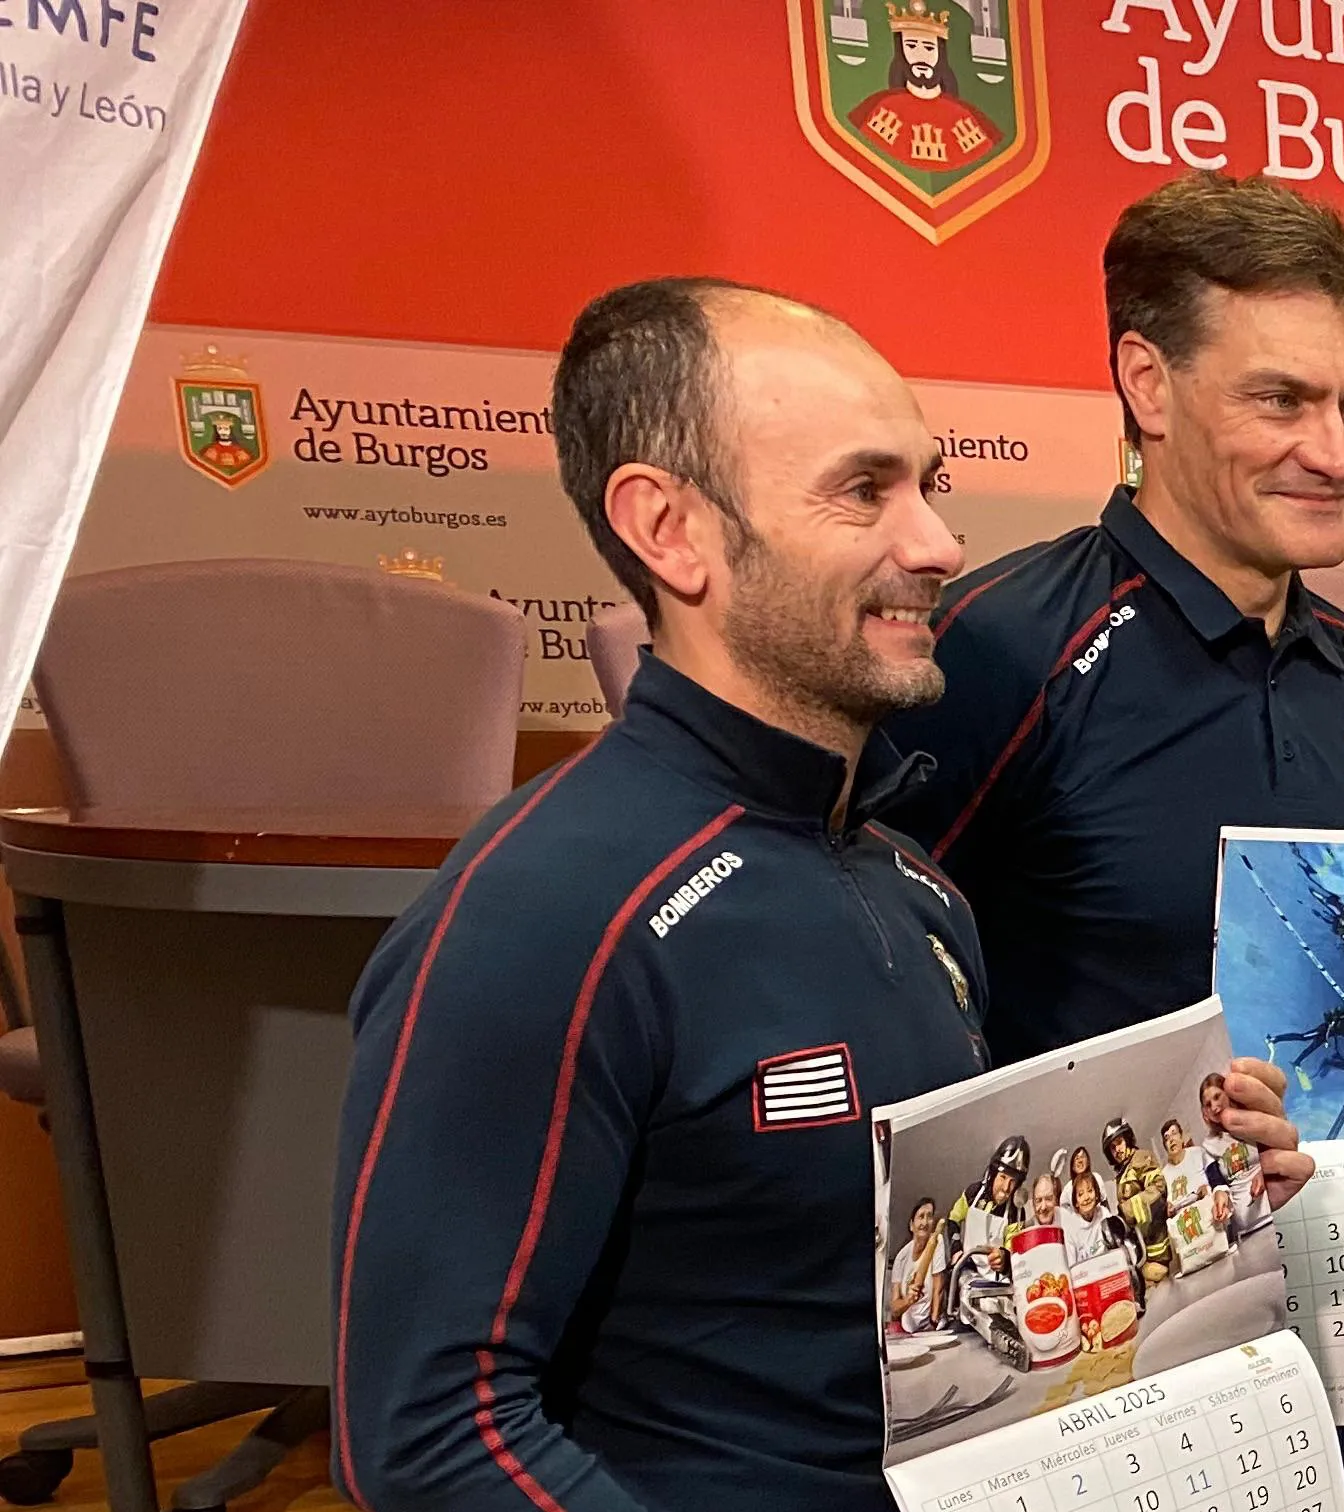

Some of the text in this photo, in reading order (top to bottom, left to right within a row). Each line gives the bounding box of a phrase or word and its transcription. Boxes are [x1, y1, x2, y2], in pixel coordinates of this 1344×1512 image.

[51, 81, 70, 118] y
[79, 81, 167, 133] León
[1104, 56, 1227, 171] de
[290, 387, 554, 435] Ayuntamient
[293, 427, 489, 477] de Burgos
[303, 506, 507, 529] www.aytoburgos.es
[1073, 605, 1136, 674] BOMOS
[649, 852, 744, 938] BOMBEROS
[937, 1368, 1299, 1512] Lunes Martes Miércoles Jueves Viernes Sábado Domingo
[1057, 1383, 1166, 1437] ABRIL 2025
[1071, 1474, 1088, 1496] 2
[1126, 1453, 1141, 1474] 3
[1181, 1432, 1193, 1452] 4
[1230, 1413, 1243, 1434] 5
[1279, 1393, 1293, 1414] 6
[1185, 1469, 1212, 1496] 11
[1237, 1449, 1262, 1475] 12
[1286, 1430, 1309, 1455] 13
[1246, 1485, 1269, 1511] 19
[1293, 1465, 1317, 1491] 20
